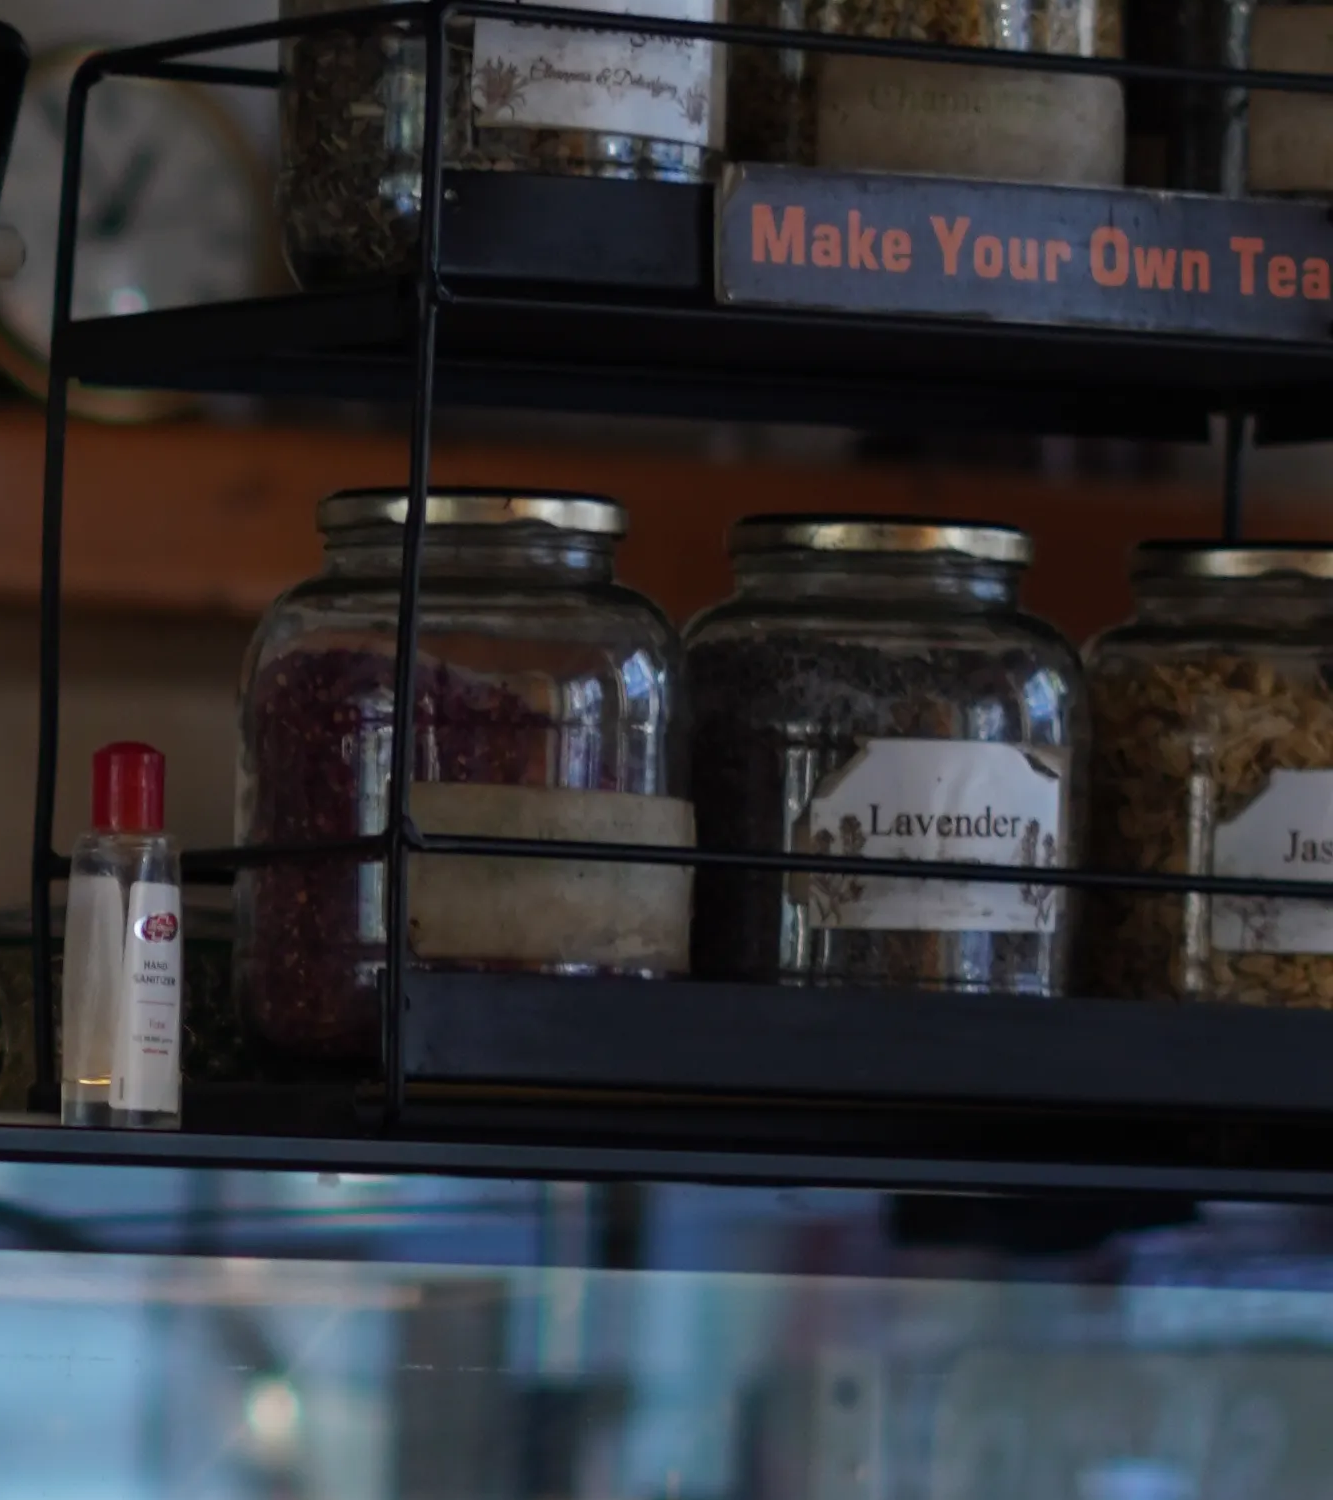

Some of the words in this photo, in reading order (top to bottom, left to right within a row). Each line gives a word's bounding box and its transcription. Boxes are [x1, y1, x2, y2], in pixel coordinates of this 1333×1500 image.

[751, 203, 912, 273] Make
[930, 216, 1071, 284] Your
[1089, 226, 1211, 293] Own
[1231, 236, 1331, 299] Tea
[869, 804, 1022, 839] Lavender
[143, 960, 168, 970] HAND
